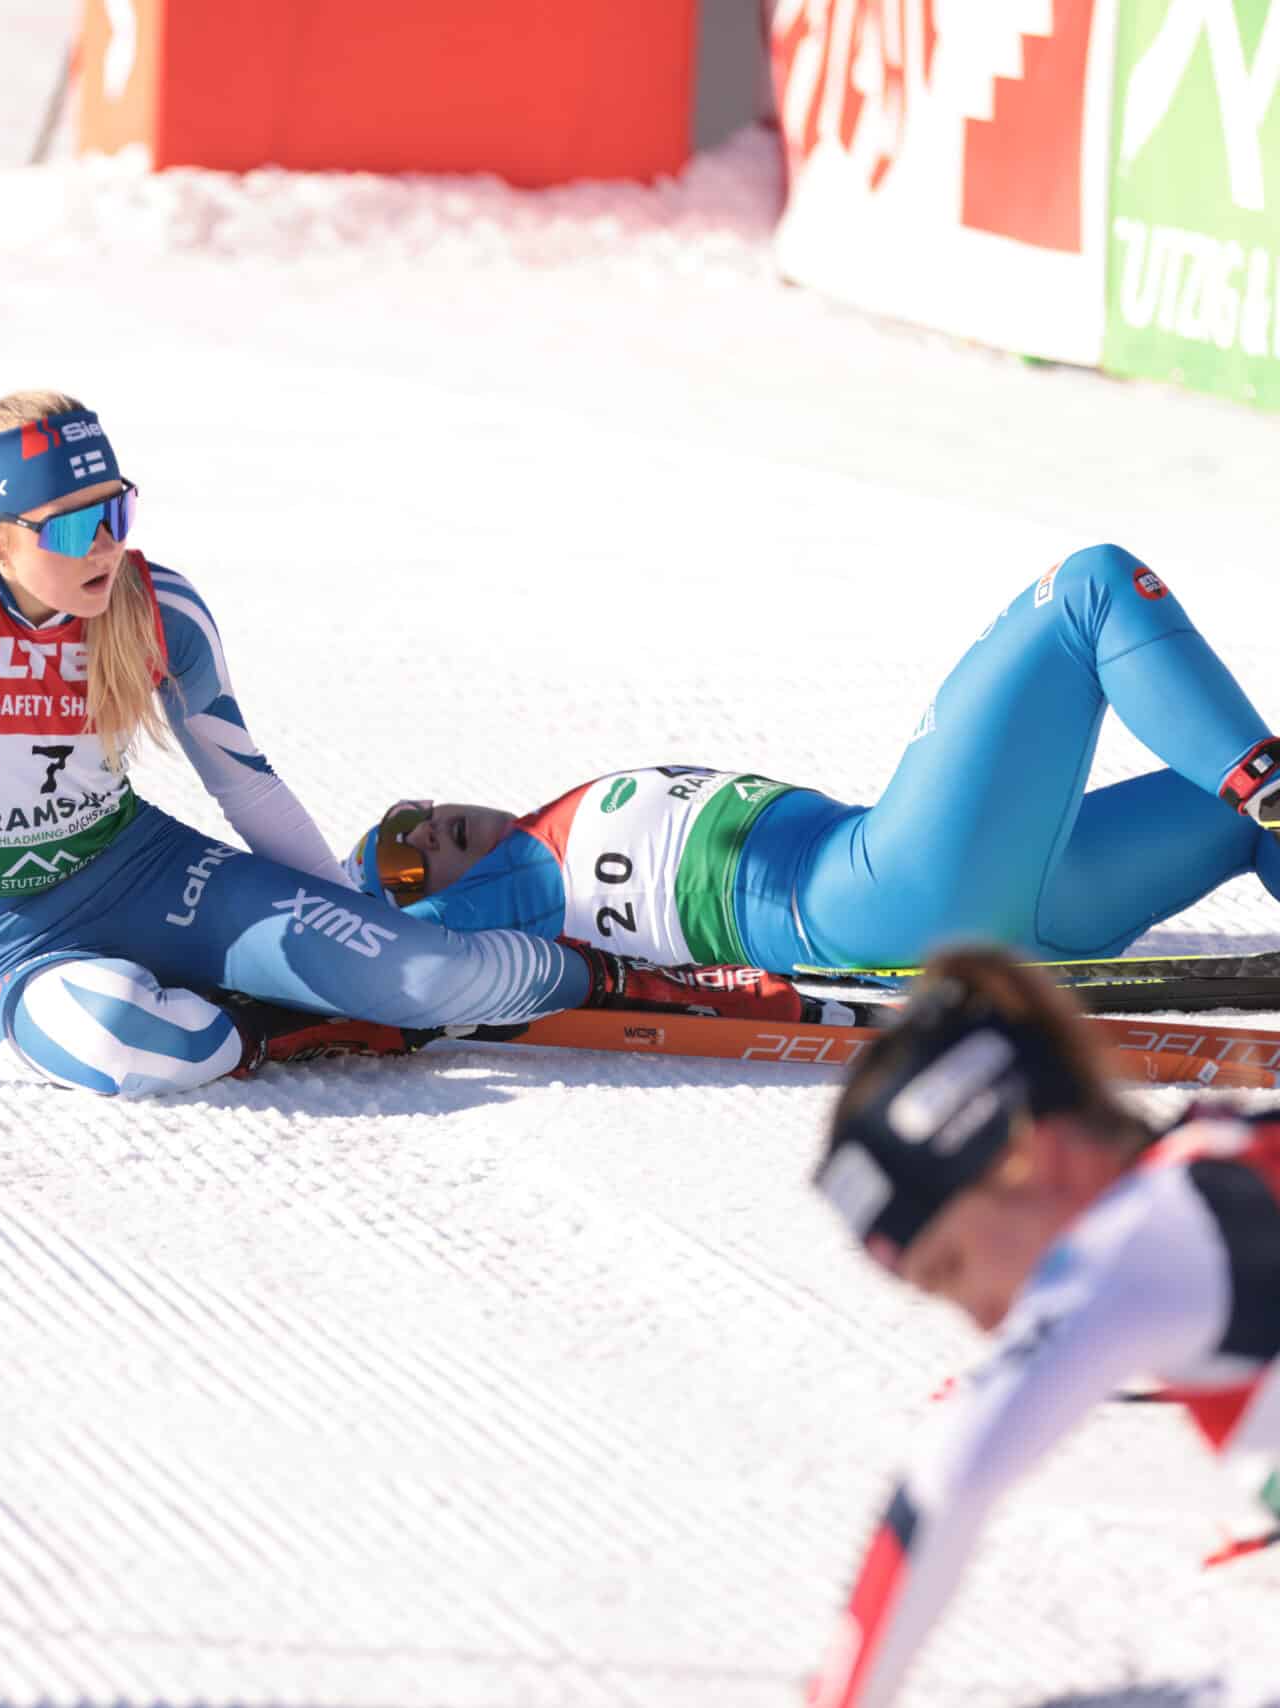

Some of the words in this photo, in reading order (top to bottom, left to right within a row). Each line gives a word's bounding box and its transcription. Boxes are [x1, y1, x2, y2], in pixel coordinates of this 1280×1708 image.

[31, 744, 75, 794] 7
[1, 875, 57, 890] STUTZIG
[594, 852, 637, 937] 20
